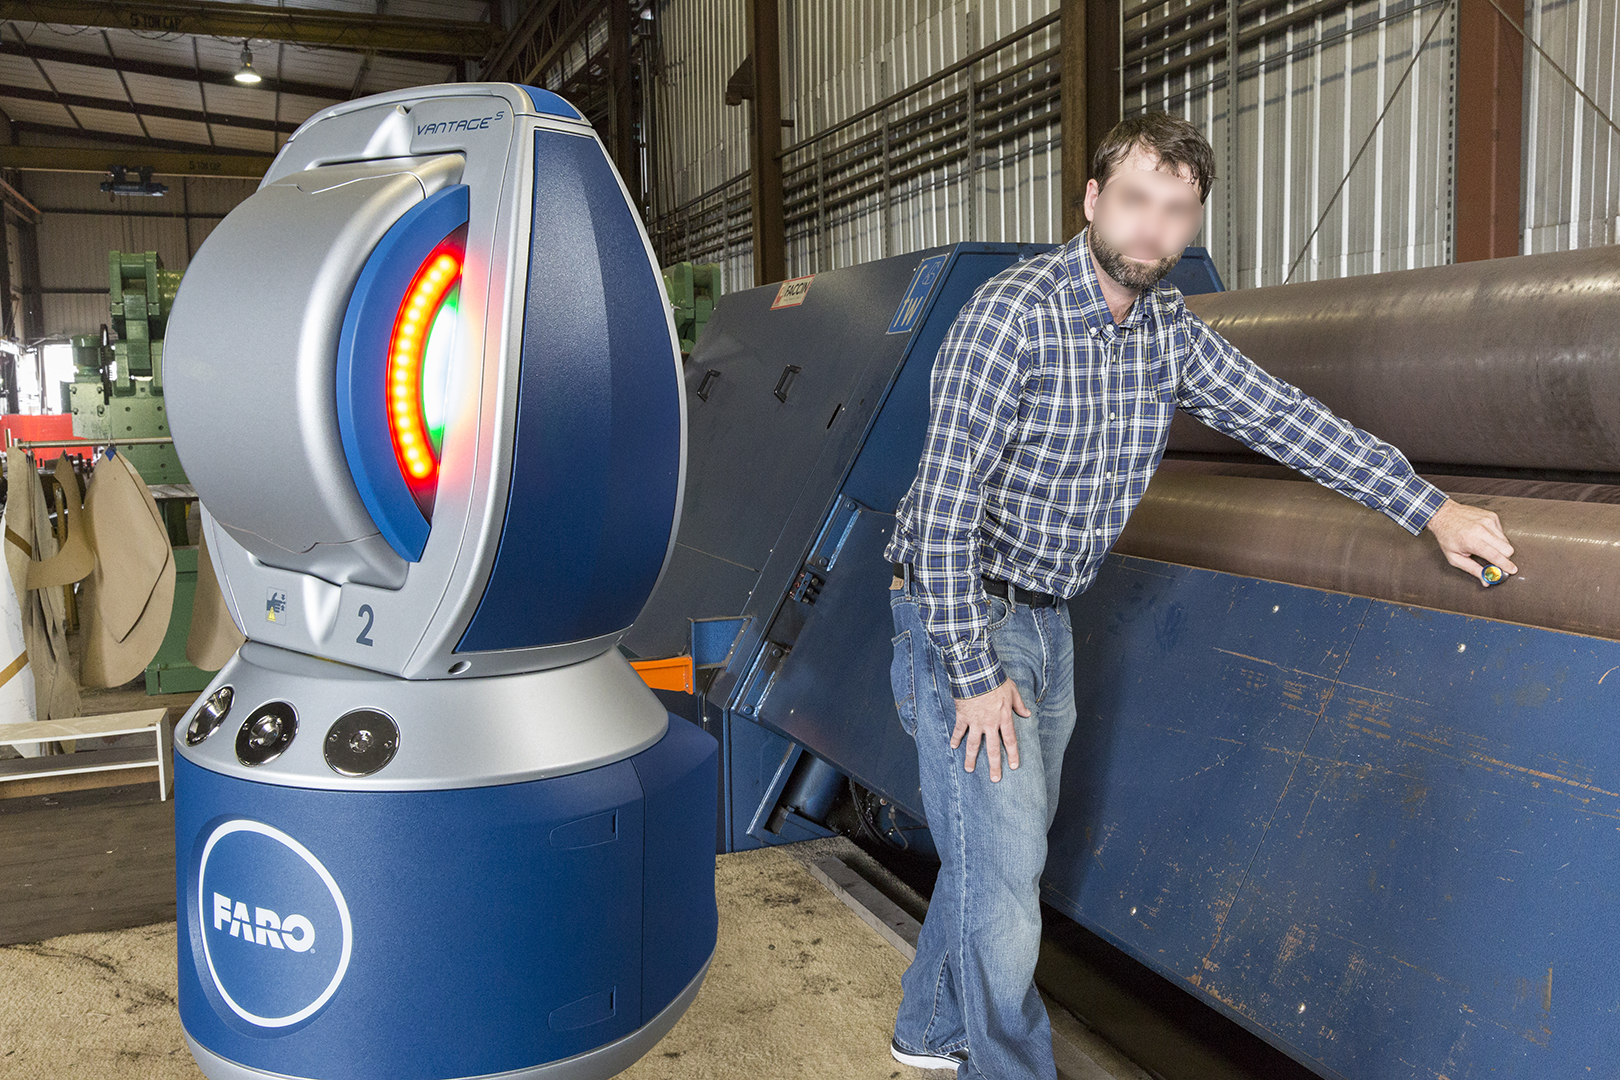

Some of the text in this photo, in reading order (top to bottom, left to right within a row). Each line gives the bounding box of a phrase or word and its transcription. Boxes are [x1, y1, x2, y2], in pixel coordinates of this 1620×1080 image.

[417, 117, 493, 136] VANTAGE
[356, 603, 375, 648] 2
[213, 891, 316, 953] FARO
